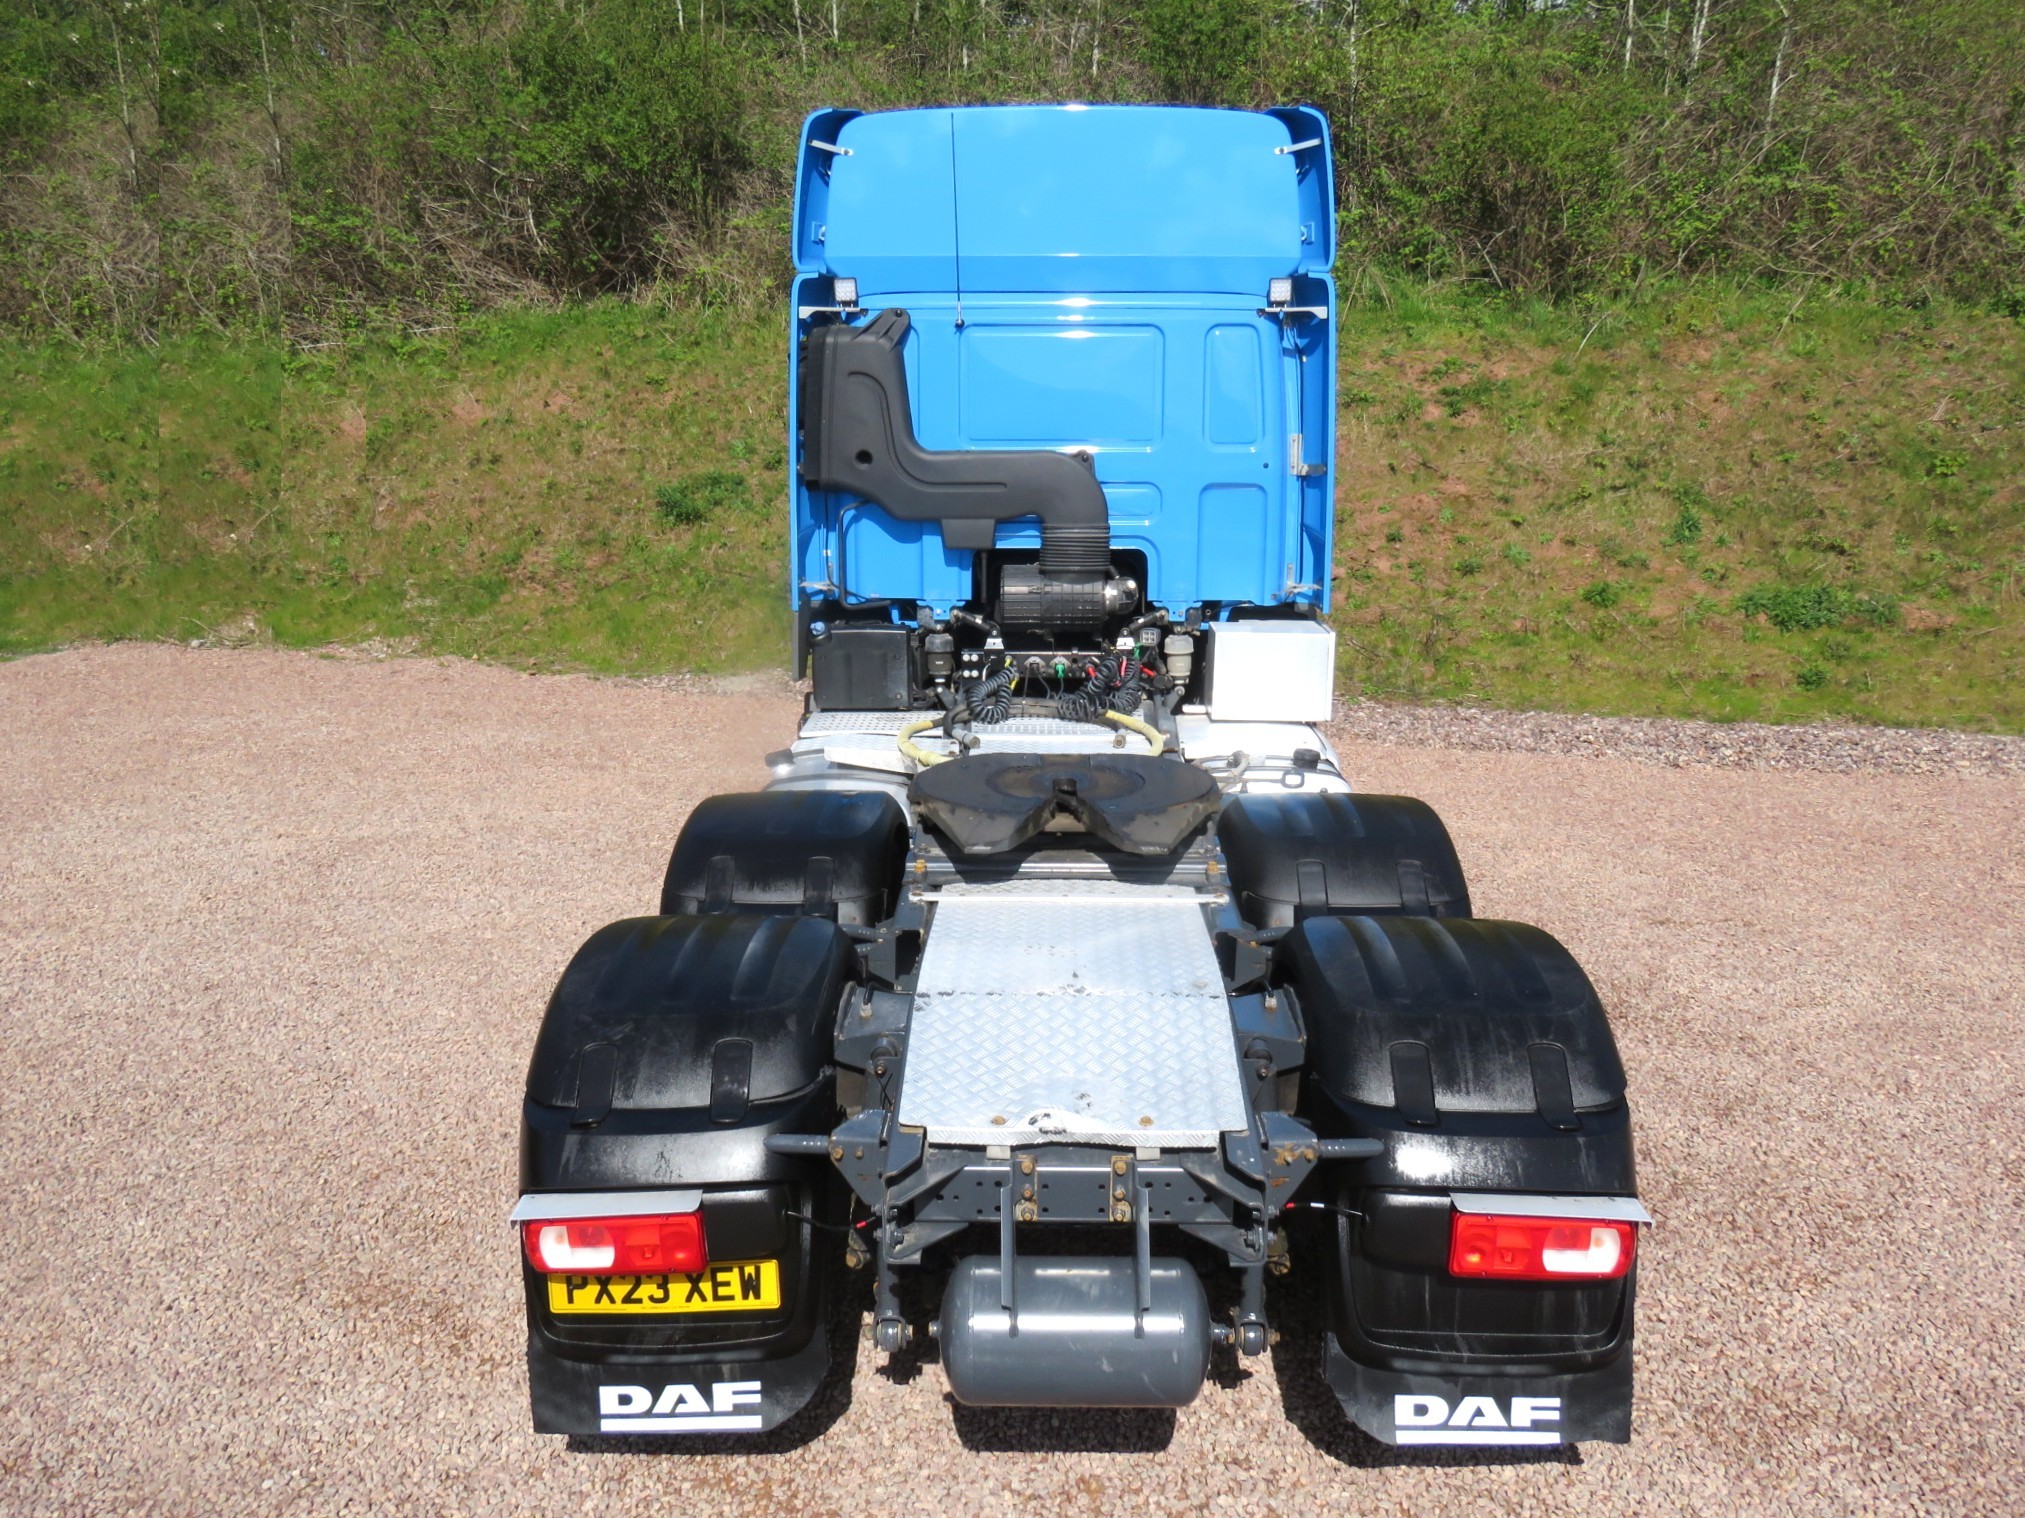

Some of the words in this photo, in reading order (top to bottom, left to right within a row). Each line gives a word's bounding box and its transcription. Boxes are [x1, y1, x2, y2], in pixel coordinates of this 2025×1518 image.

[565, 1274, 670, 1304] PX23
[684, 1265, 761, 1303] XEW
[599, 1381, 761, 1414] DAF
[1394, 1394, 1561, 1427] DAF
